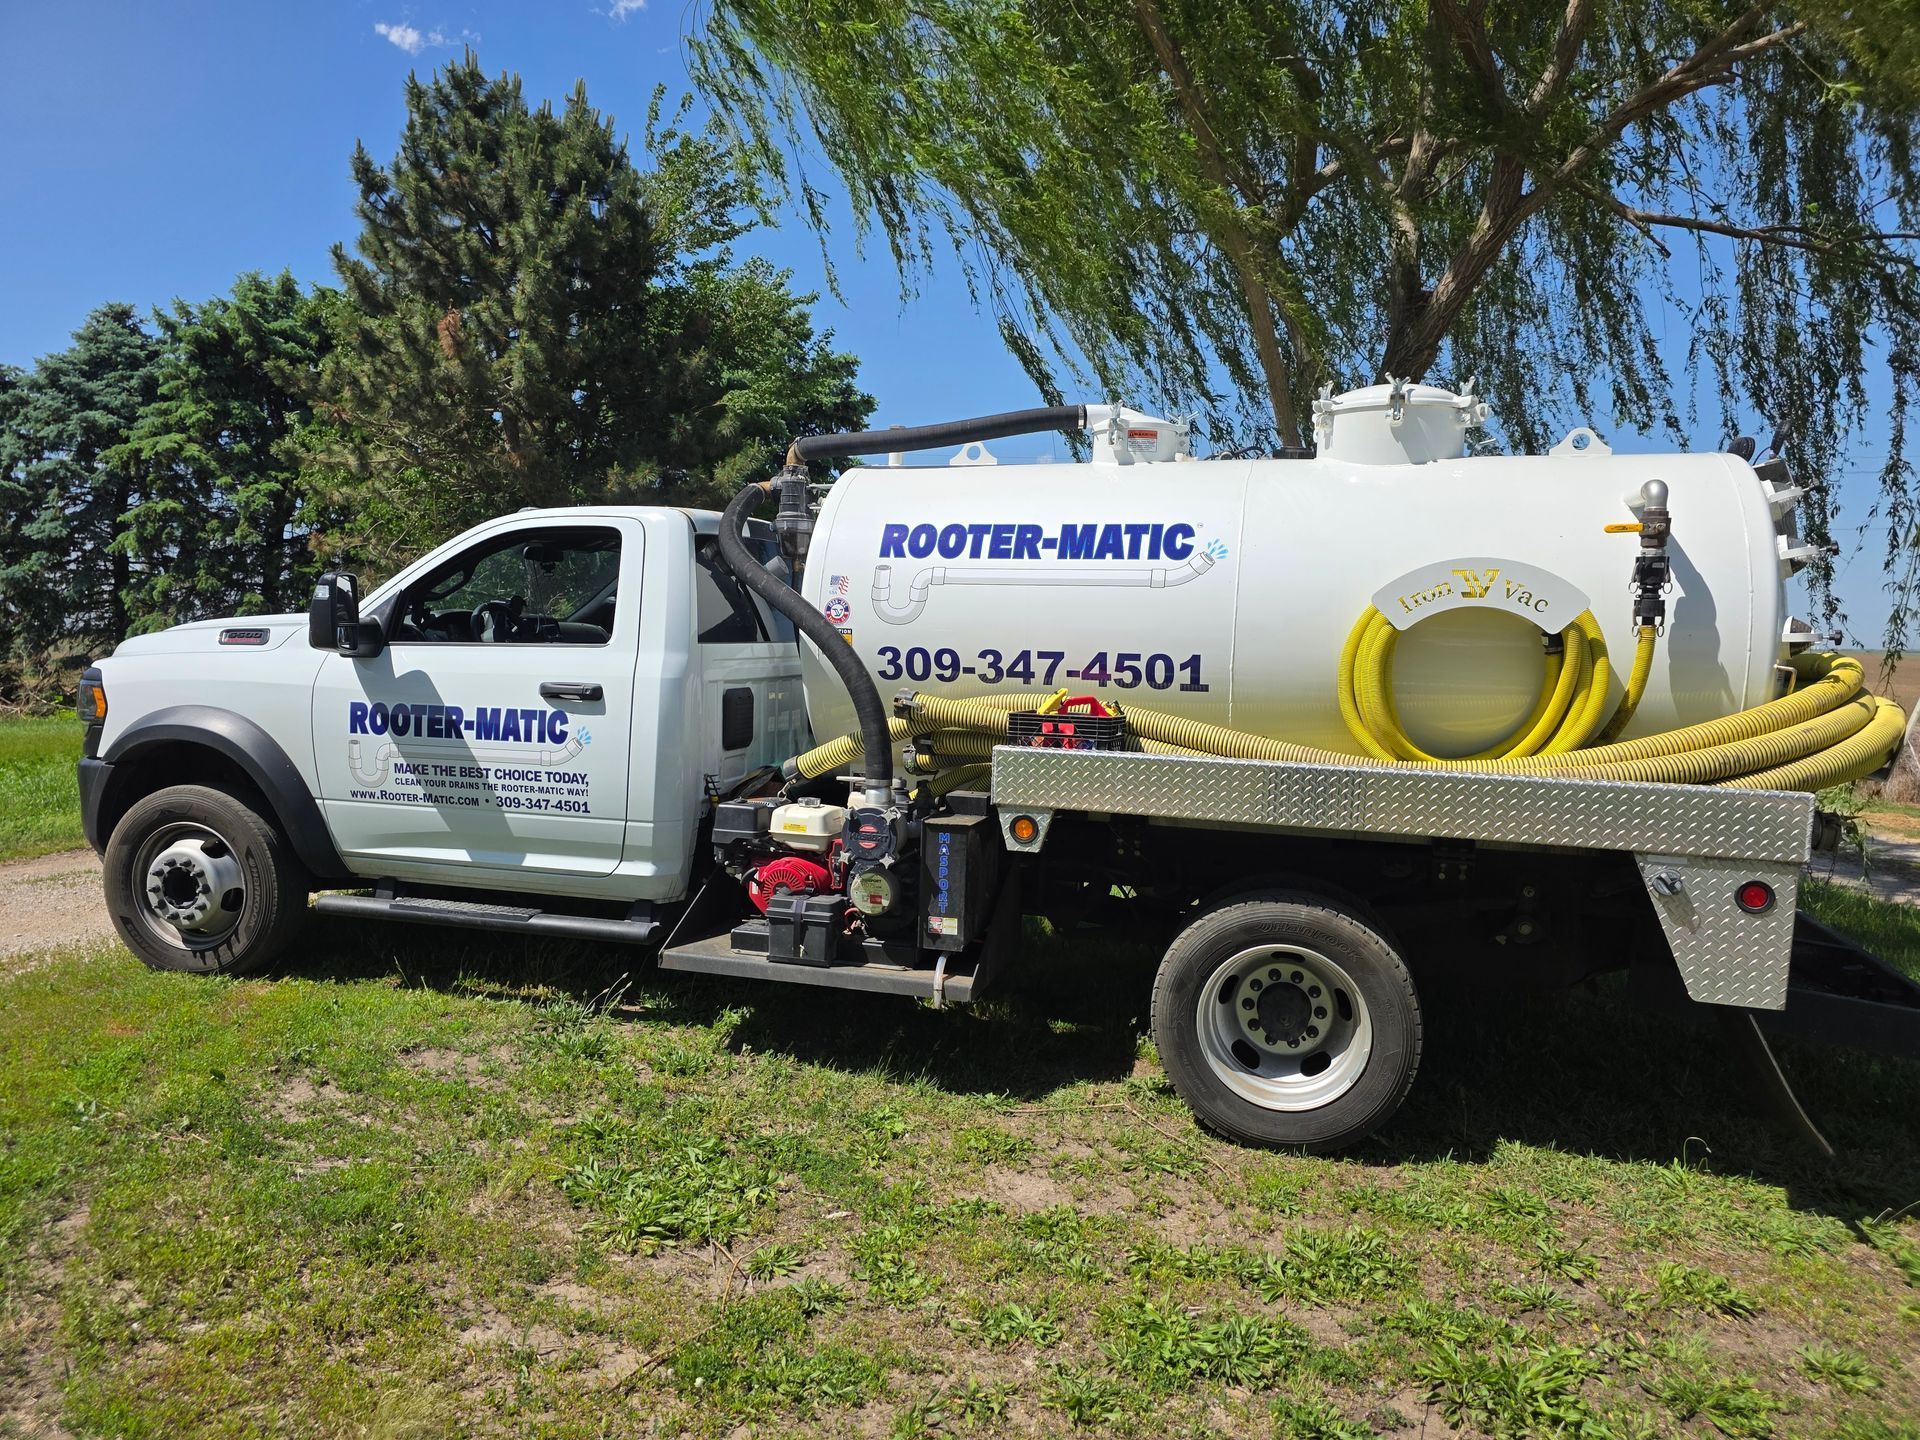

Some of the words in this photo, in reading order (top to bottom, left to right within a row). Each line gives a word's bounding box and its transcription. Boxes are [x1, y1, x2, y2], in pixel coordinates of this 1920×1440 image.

[879, 523, 1196, 560] ROOTER-MATIC
[1397, 581, 1454, 614] Iron
[1504, 578, 1549, 613] Vac
[877, 646, 1209, 693] 309-347-4501
[349, 701, 569, 745] ROOTER-MATIC
[394, 763, 429, 775] MAKE
[432, 765, 457, 777] THE
[460, 766, 491, 780] BEST
[494, 768, 542, 783] CHOICE
[545, 771, 589, 787] TODAY,
[395, 777, 421, 787] CLEAN
[424, 779, 447, 788] YOUR
[449, 780, 480, 790] DRAINS
[482, 782, 499, 791] THE
[501, 783, 564, 796] ROOTER-MATIC
[567, 786, 589, 797] WAY!
[496, 796, 590, 814] 309-347-4501
[938, 832, 951, 914] MASPORT
